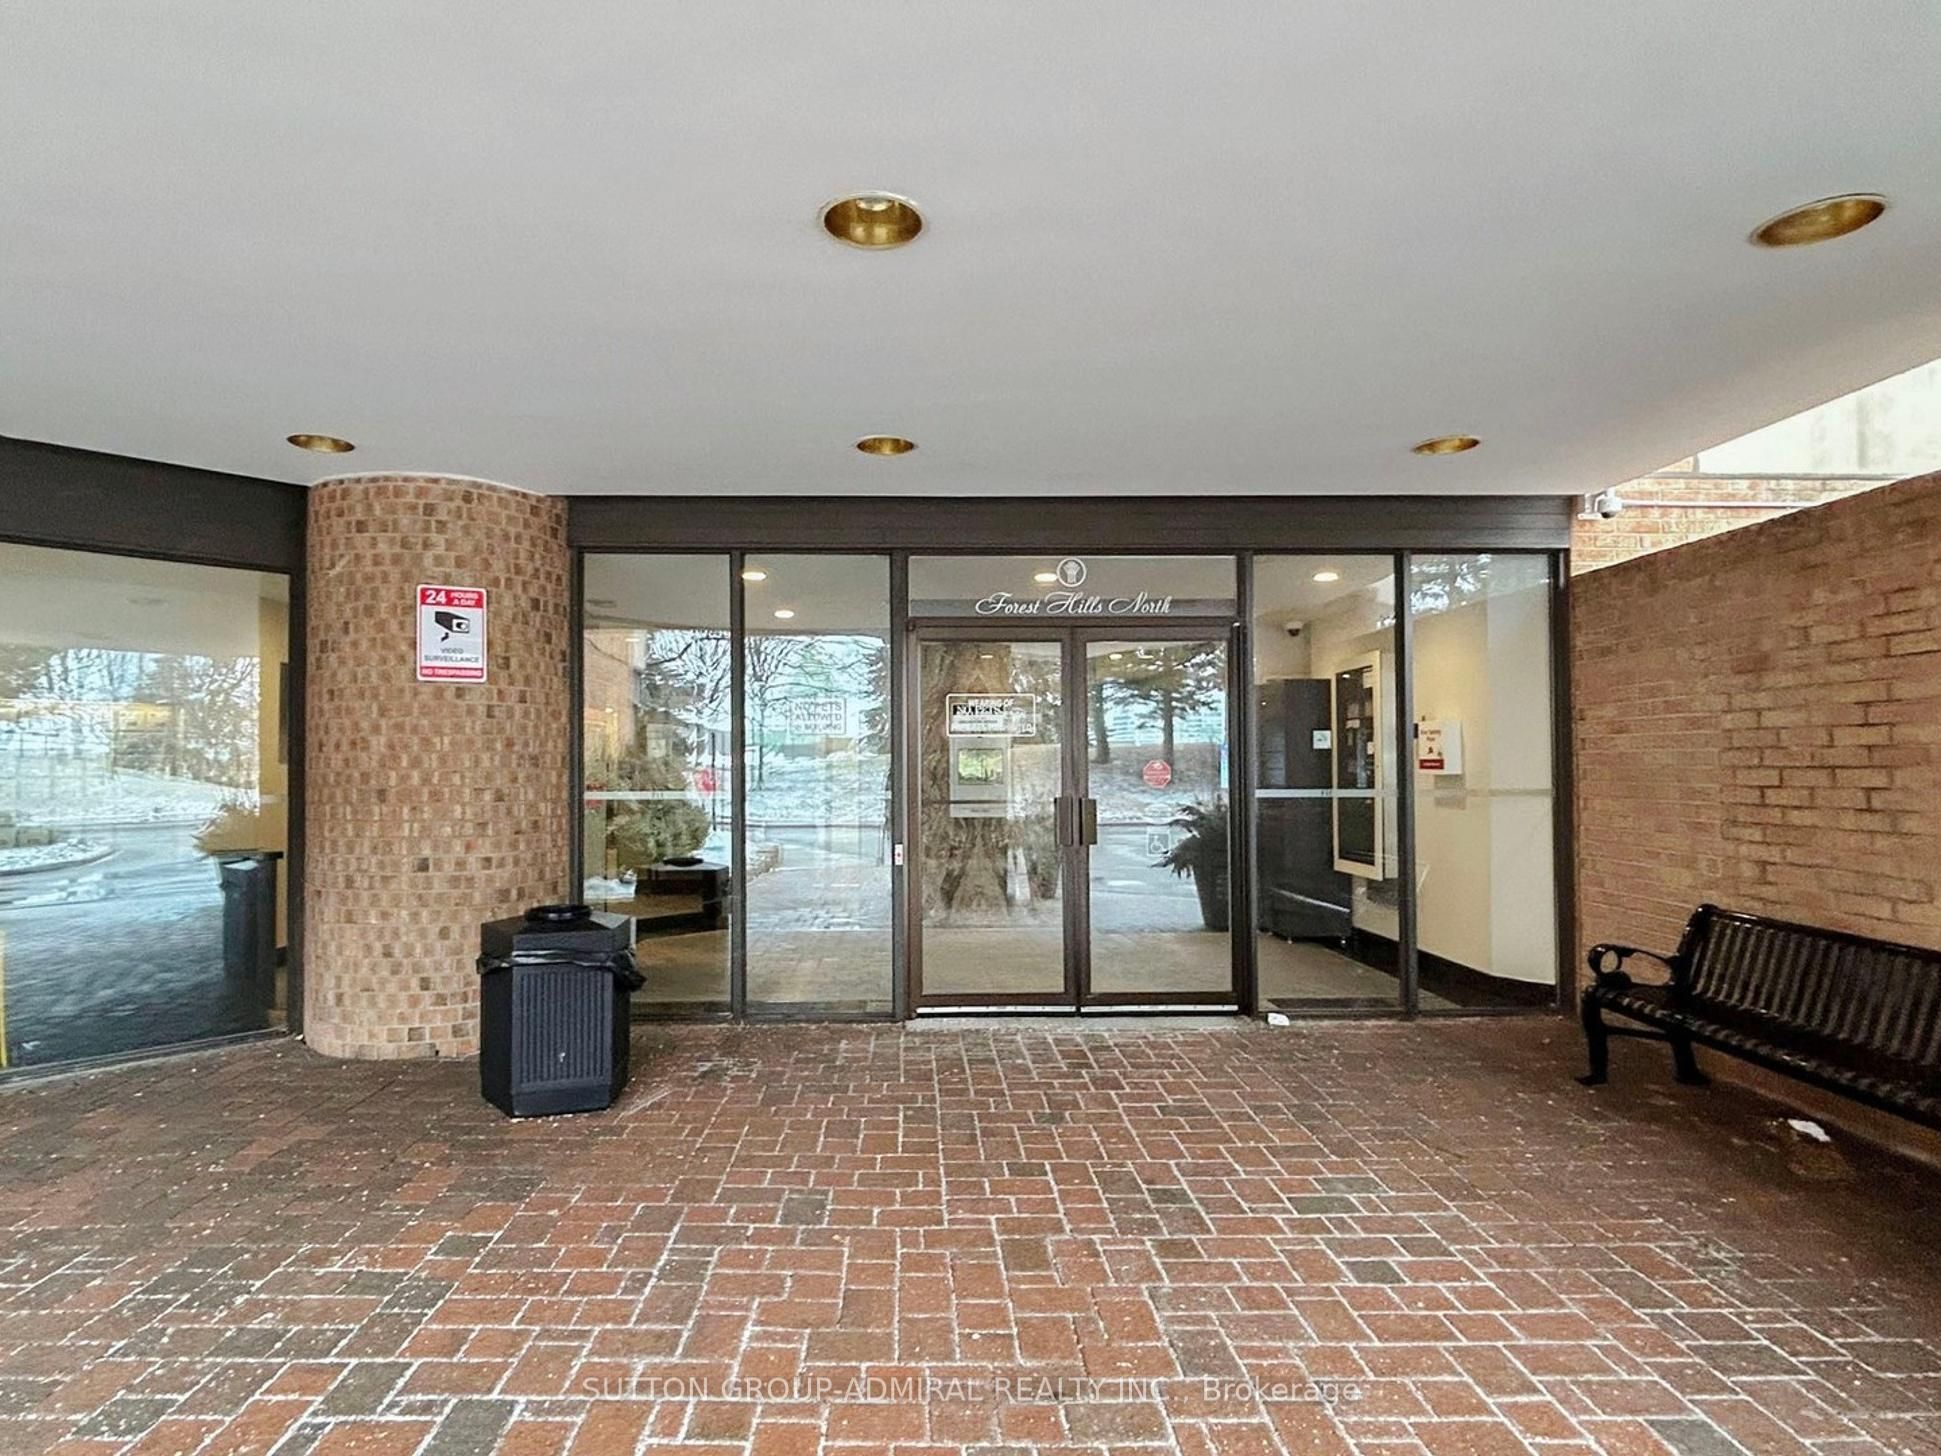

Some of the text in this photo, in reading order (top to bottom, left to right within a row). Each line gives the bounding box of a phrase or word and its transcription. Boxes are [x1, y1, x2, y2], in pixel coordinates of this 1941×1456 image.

[425, 590, 447, 605] 24
[975, 591, 1173, 615] Forest Hills North
[423, 655, 480, 663] SURVEILLANCE
